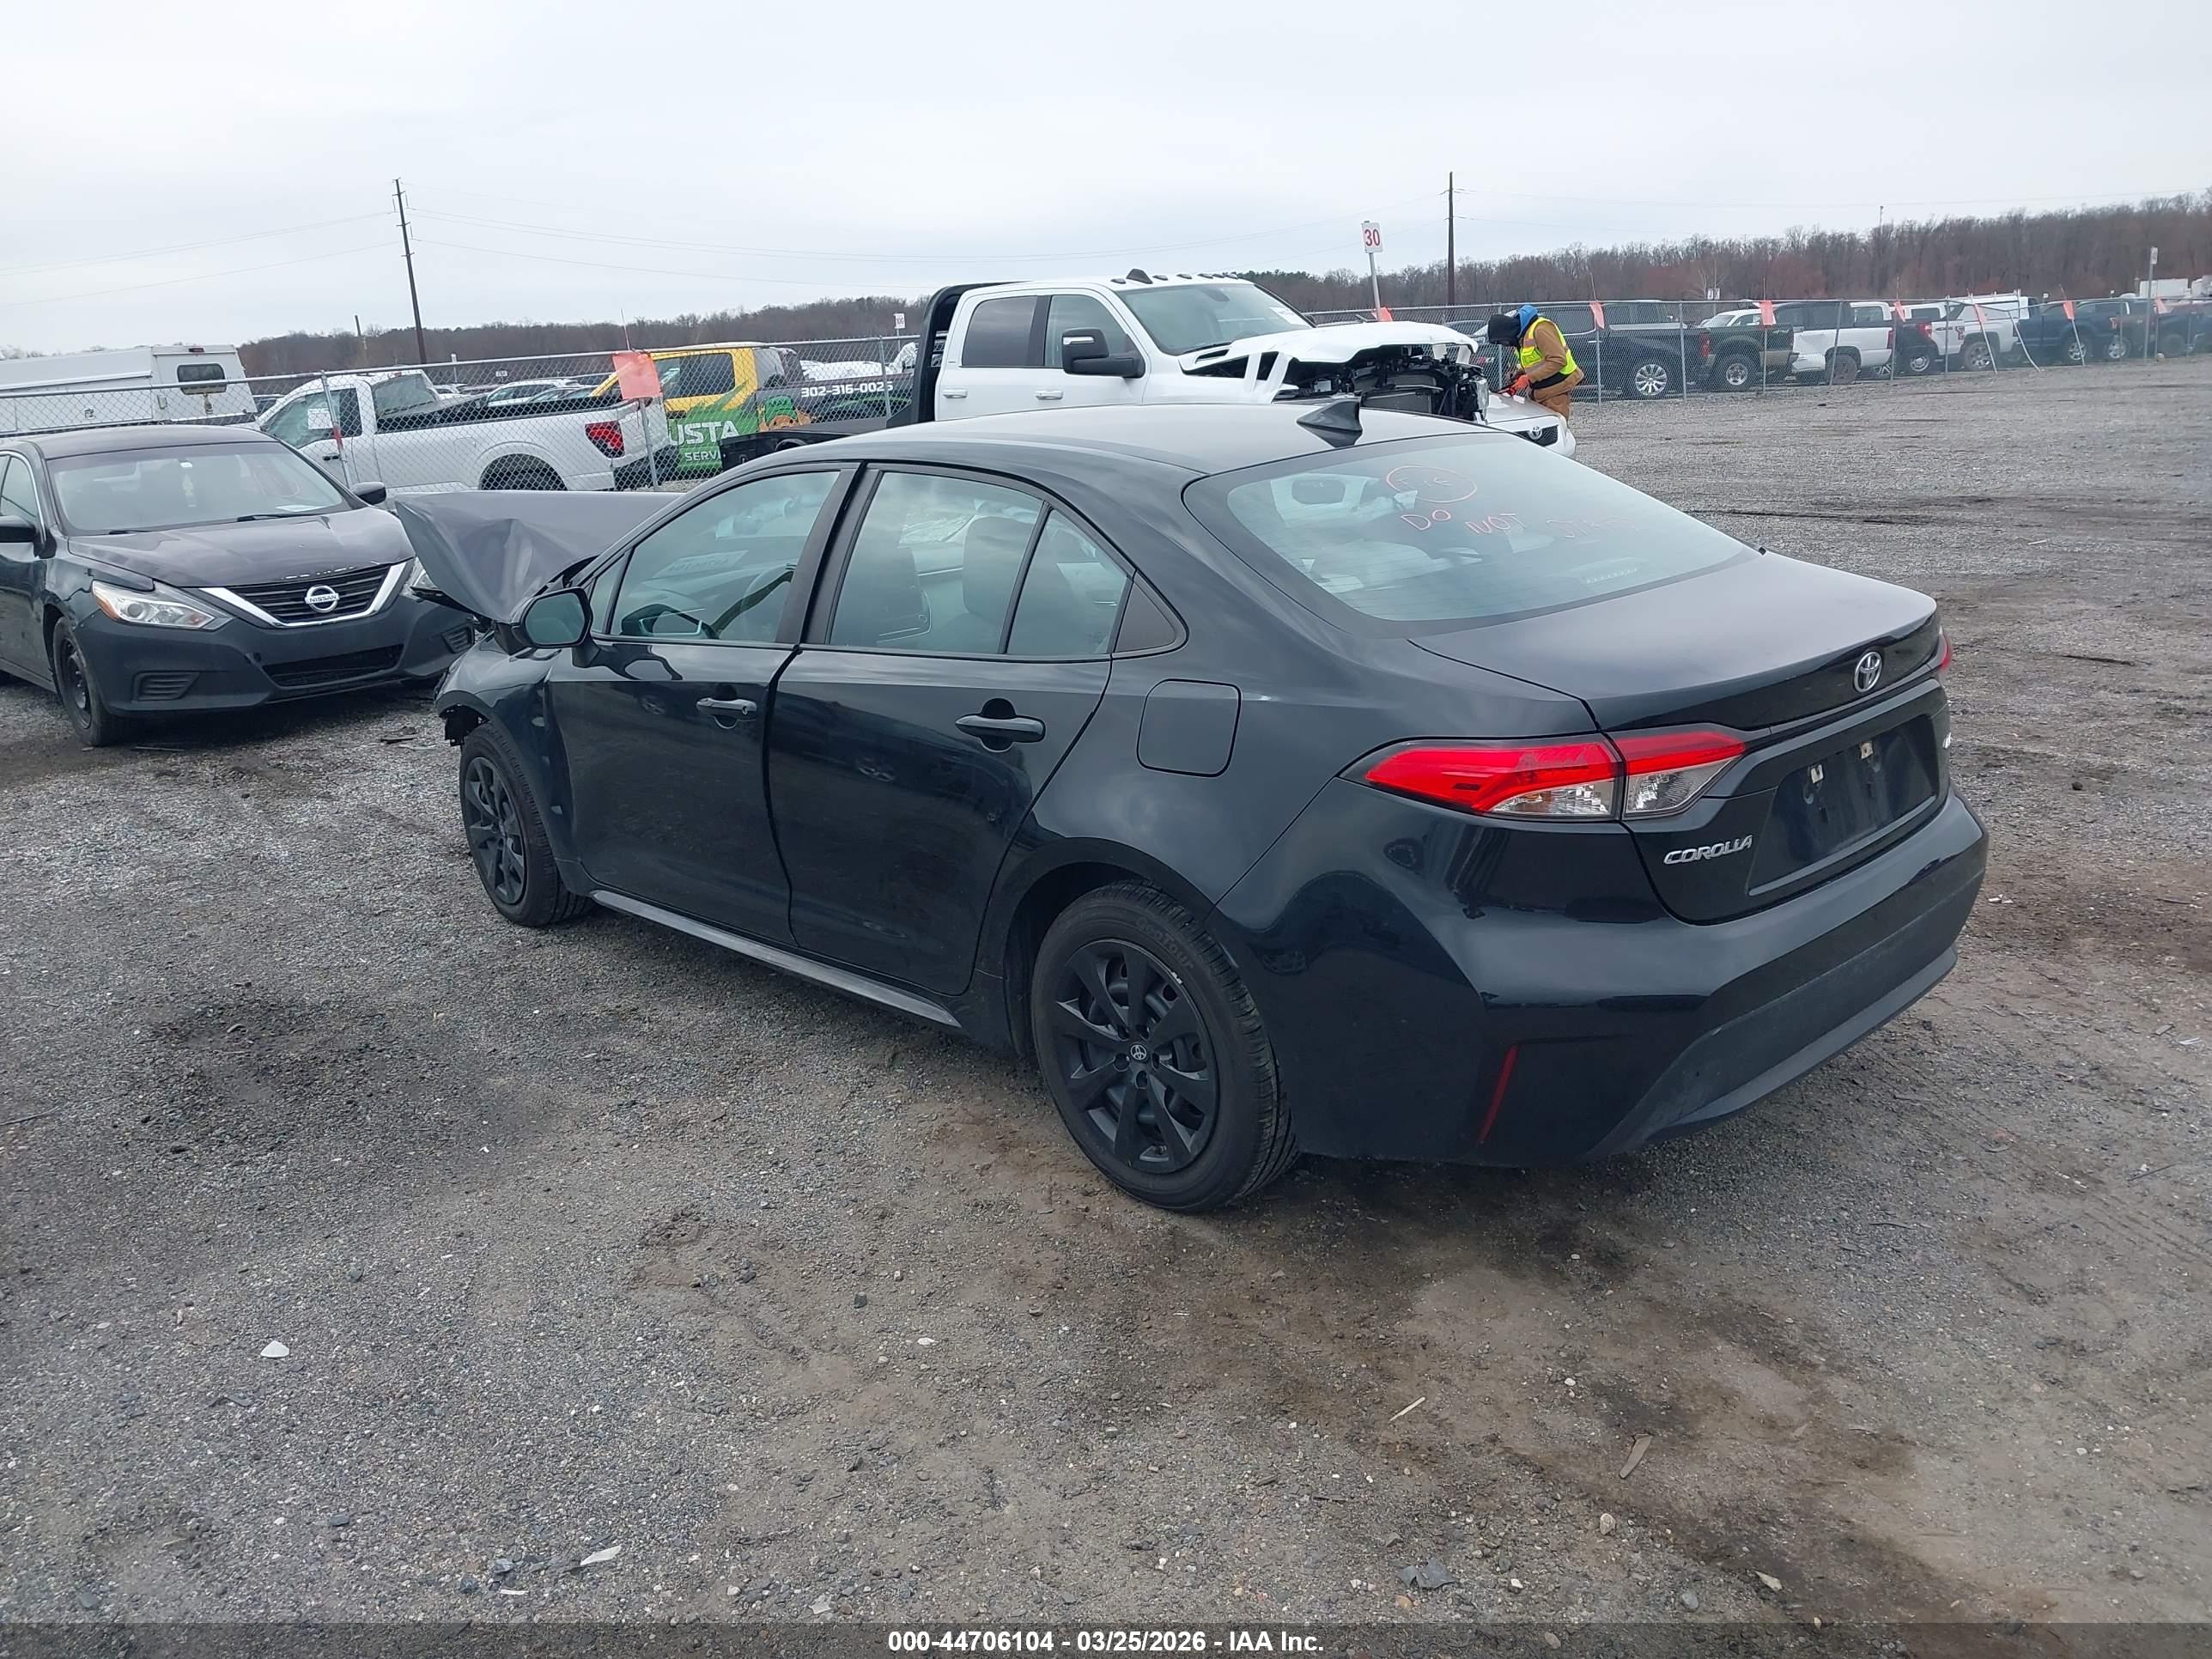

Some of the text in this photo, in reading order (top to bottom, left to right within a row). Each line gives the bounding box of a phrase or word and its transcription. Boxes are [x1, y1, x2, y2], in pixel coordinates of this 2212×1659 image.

[1364, 228, 1381, 246] 30
[800, 381, 894, 398] 302-316-0025
[1401, 508, 1452, 531] DO
[1464, 513, 1528, 534] NOT
[309, 594, 337, 603] NISSAN
[1662, 834, 1753, 865] COROLLA
